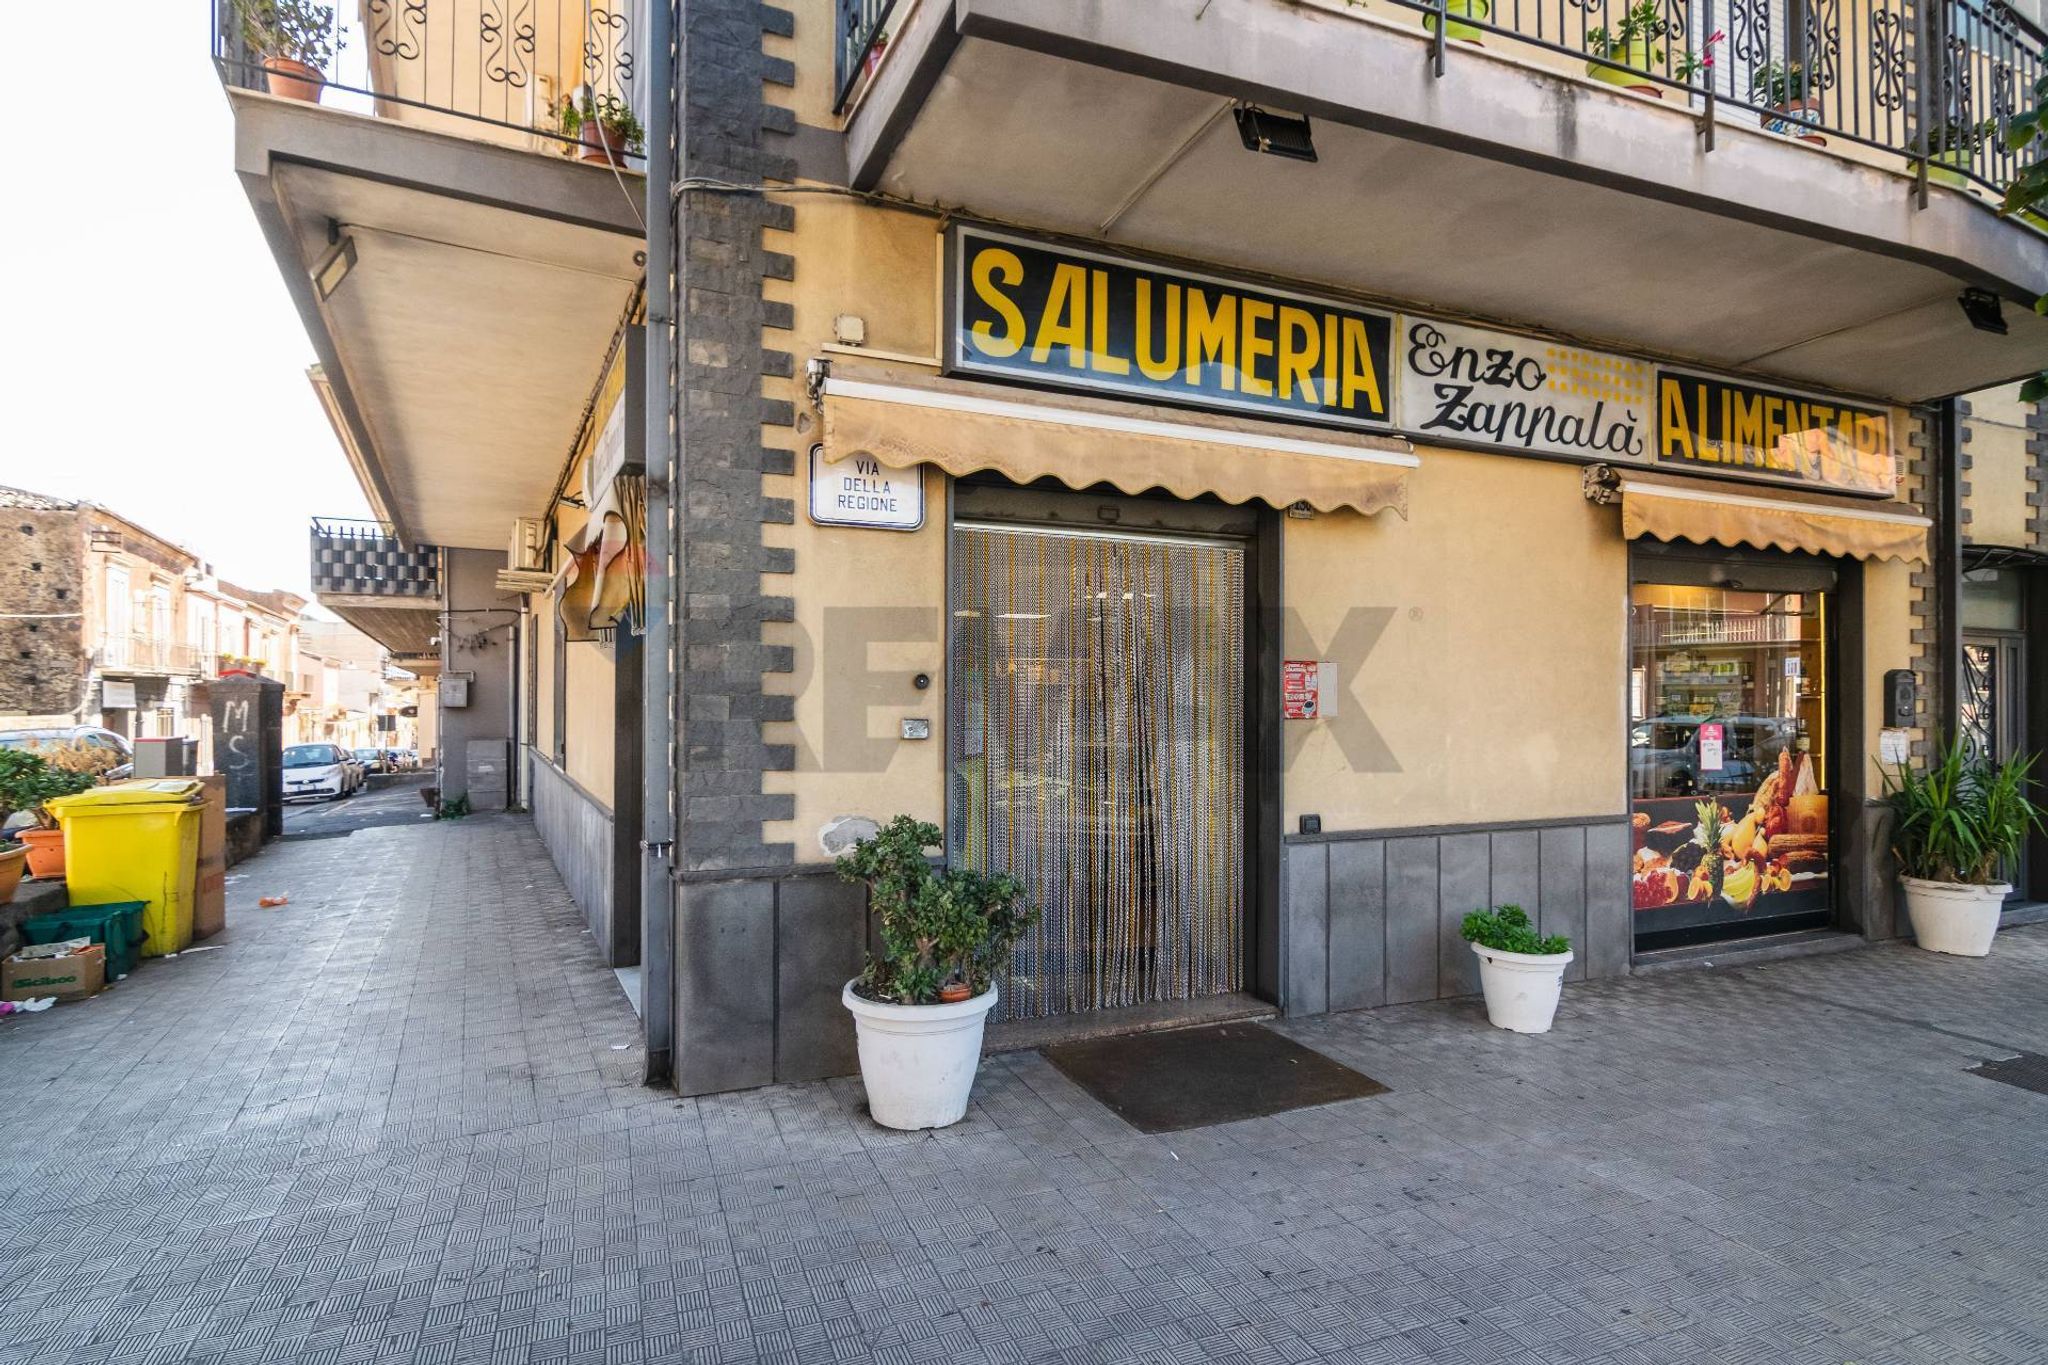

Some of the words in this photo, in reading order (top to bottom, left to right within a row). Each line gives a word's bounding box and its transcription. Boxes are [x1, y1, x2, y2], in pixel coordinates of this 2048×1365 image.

[971, 248, 1384, 414] SALUMERIA
[1408, 323, 1547, 391] Enzo
[1419, 383, 1643, 456] Zappalà
[843, 476, 891, 494] DELLA
[856, 460, 880, 475] VIA
[838, 494, 898, 512] REGIONE
